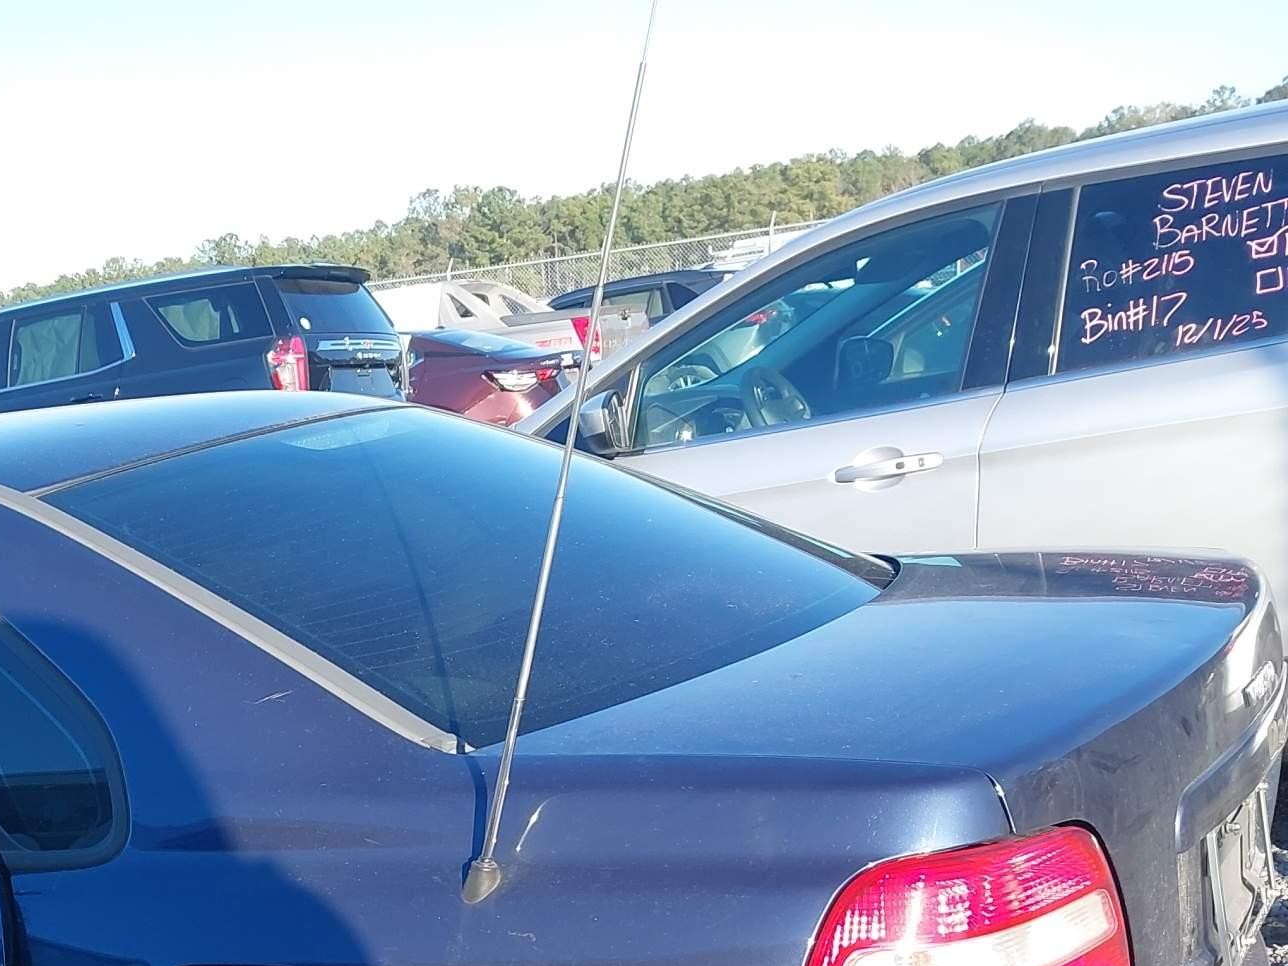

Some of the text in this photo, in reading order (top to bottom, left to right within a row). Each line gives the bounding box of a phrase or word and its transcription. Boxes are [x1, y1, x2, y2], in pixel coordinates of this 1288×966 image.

[1157, 168, 1273, 212] STEVEN
[1080, 291, 1188, 344] Bin#17
[1175, 310, 1269, 347] 12/1/25
